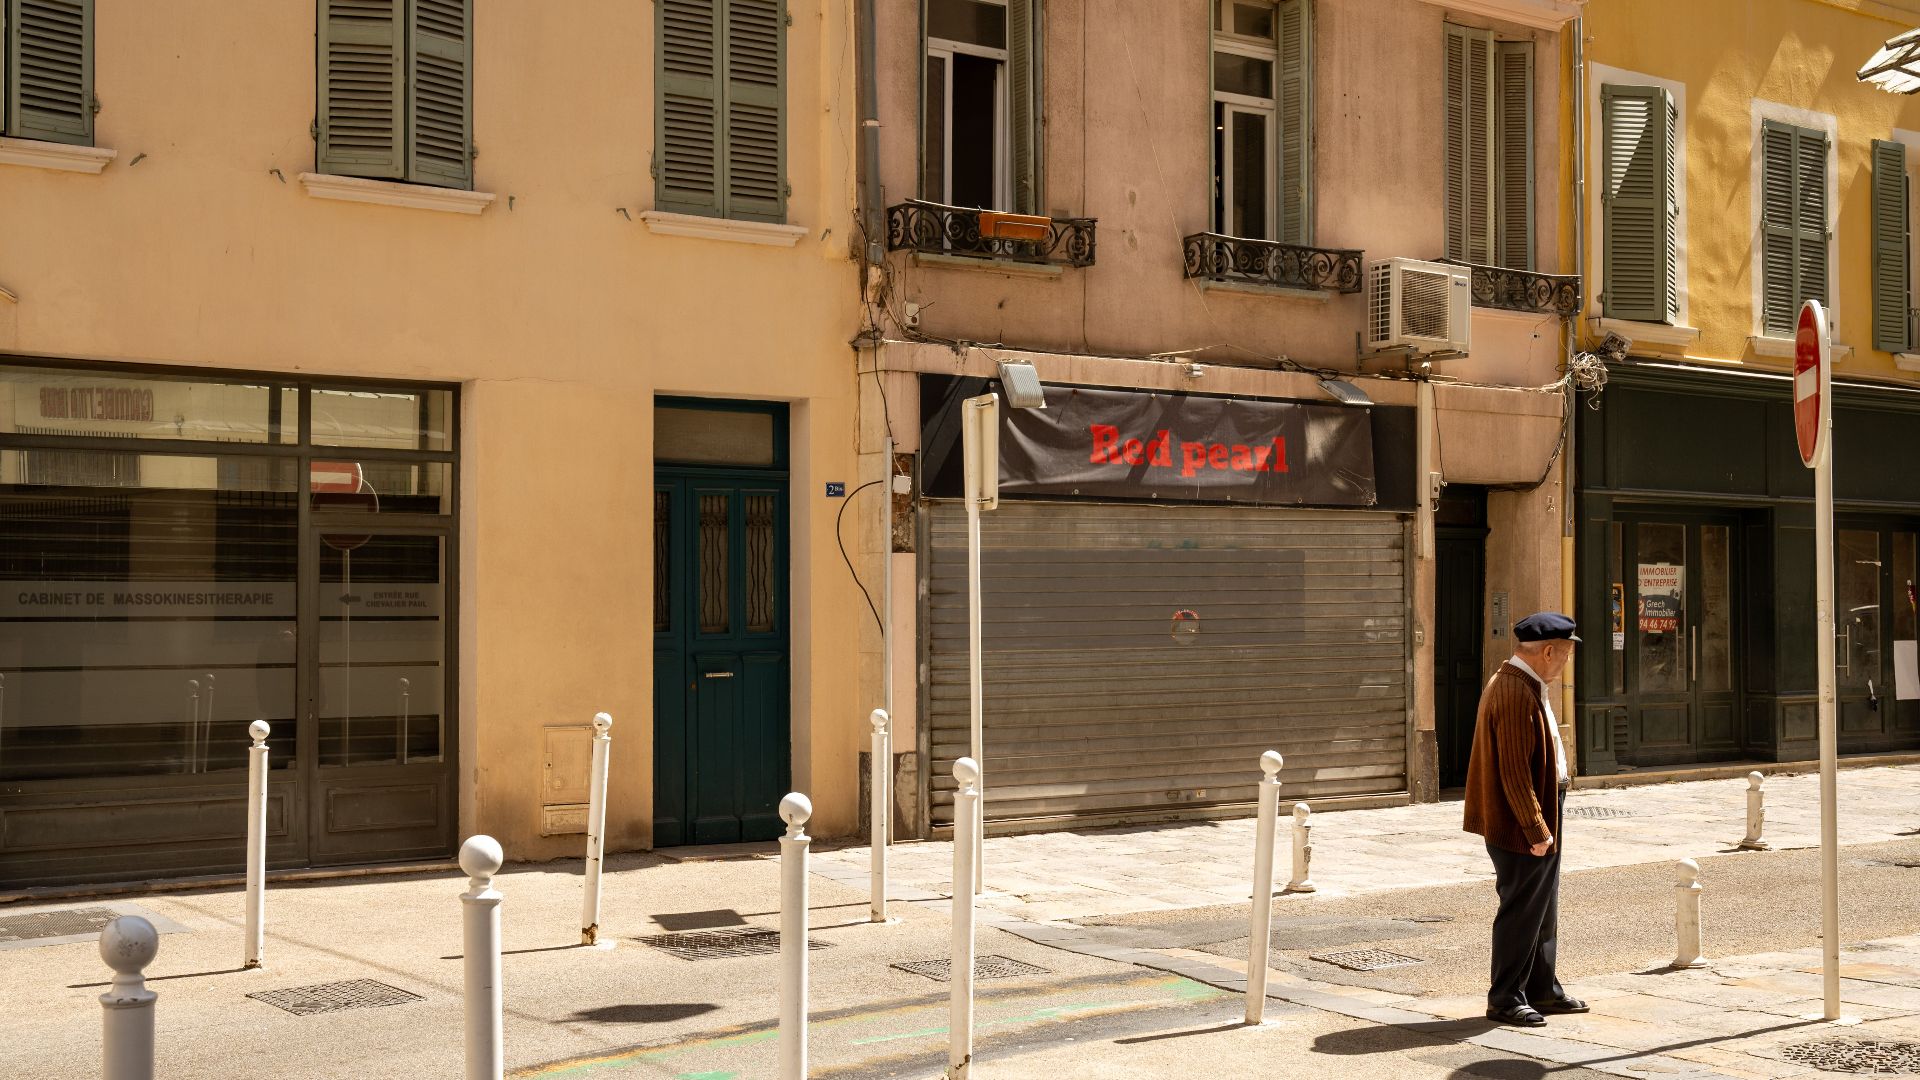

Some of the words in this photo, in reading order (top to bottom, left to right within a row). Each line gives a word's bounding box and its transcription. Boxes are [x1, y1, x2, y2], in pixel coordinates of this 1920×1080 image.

[1089, 423, 1173, 467] Red
[1180, 436, 1289, 478] pearl
[1640, 567, 1677, 576] IMMOBILIER
[18, 593, 82, 605] CABINET
[86, 593, 105, 605] DE
[113, 593, 274, 605] MASSOKINESITHERAPIE
[404, 592, 420, 600] RUE
[1645, 608, 1676, 617] Immobilier
